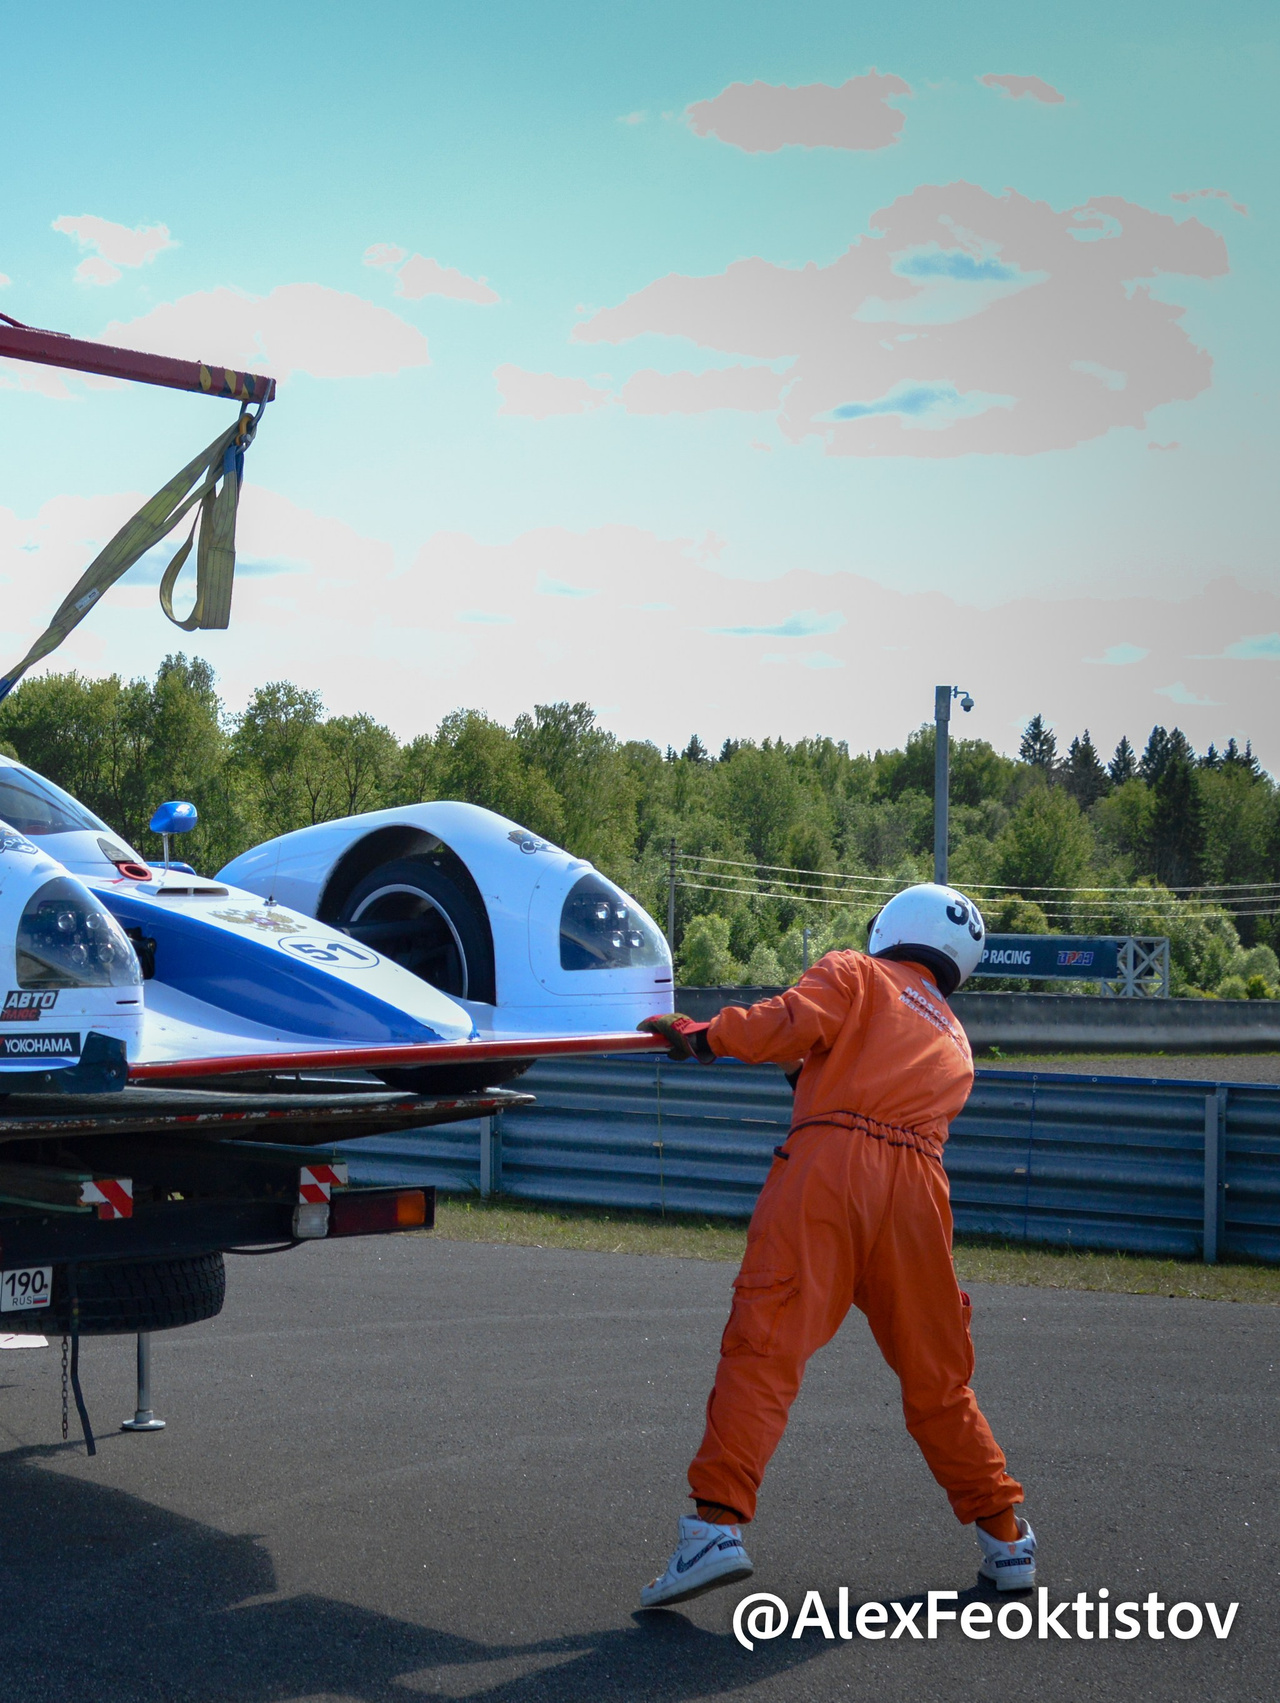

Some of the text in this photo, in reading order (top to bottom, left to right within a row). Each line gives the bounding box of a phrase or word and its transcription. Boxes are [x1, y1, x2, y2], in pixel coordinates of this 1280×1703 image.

[288, 943, 370, 961] 51
[990, 950, 1031, 965] RACING
[6, 992, 55, 1008] АВТО
[5, 1038, 72, 1053] YOKOHAMA
[5, 1270, 45, 1297] 190
[12, 1296, 32, 1306] RUS
